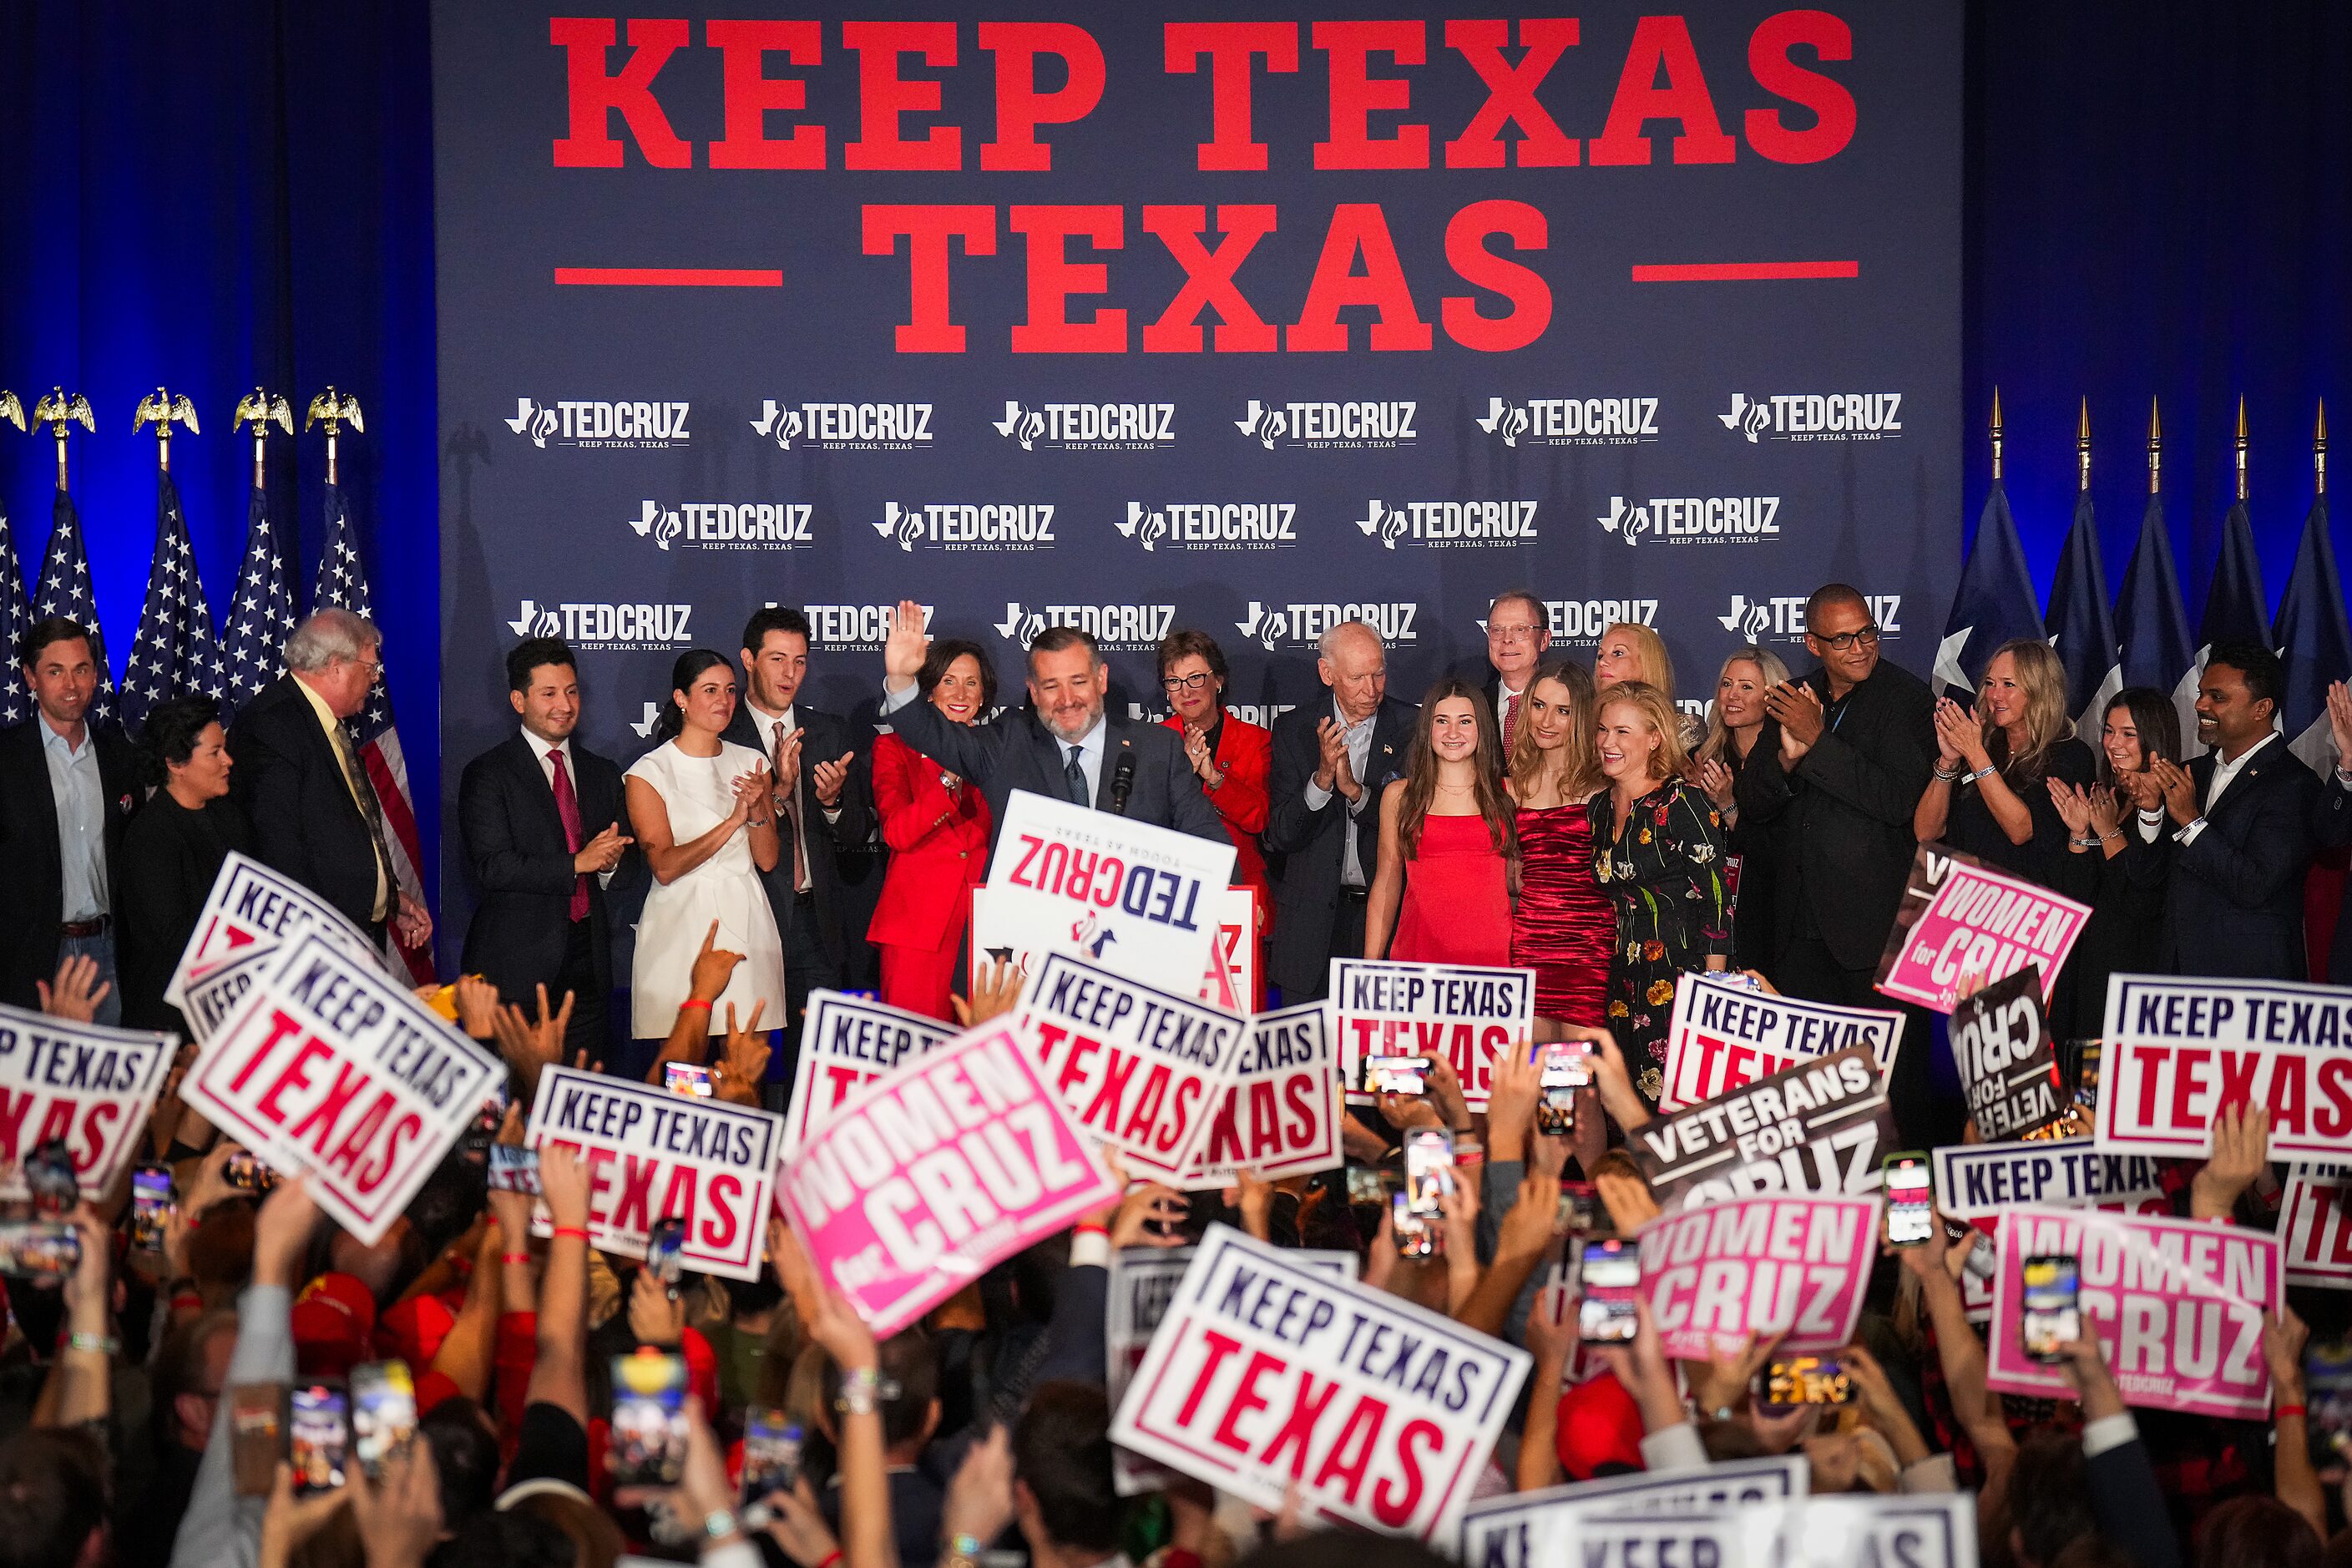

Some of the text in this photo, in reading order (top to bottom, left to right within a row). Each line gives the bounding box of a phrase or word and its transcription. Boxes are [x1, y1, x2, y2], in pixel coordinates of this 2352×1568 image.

[550, 9, 1858, 171] KEEP TEXAS
[862, 200, 1554, 353] TEXAS
[558, 402, 689, 438] TEDCRUZ
[802, 403, 933, 440] TEDCRUZ
[1044, 404, 1175, 441] TEDCRUZ
[1287, 402, 1417, 438] TEDCRUZ
[1528, 398, 1658, 436] TEDCRUZ
[1770, 393, 1901, 431] TEDCRUZ
[579, 440, 602, 448] KEEP
[605, 441, 637, 449] TEXAS,
[848, 443, 880, 451] TEXAS,
[1091, 443, 1123, 451] TEXAS,
[1333, 441, 1364, 449] TEXAS,
[1368, 440, 1396, 448] TEXAS
[1609, 437, 1638, 445] TEXAS
[1817, 433, 1849, 442] TEXAS,
[1851, 432, 1881, 441] TEXAS
[681, 504, 812, 541] TEDCRUZ
[924, 505, 1055, 541] TEDCRUZ
[1166, 504, 1297, 541] TEDCRUZ
[1408, 501, 1538, 538] TEDCRUZ
[1649, 497, 1780, 534] TEDCRUZ
[728, 543, 760, 551] TEXAS,
[1212, 543, 1244, 551] TEXAS,
[1428, 539, 1517, 549] KEEP TEXAS, TEXAS
[1696, 536, 1727, 544] TEXAS,
[560, 604, 691, 641] TEDCRUZ
[803, 605, 934, 642] TEDCRZ
[1541, 599, 1658, 637] EDCRUZ
[1770, 595, 1901, 634] TEUZ
[581, 642, 604, 650] KEEP
[607, 643, 639, 651] TEXAS,
[1098, 644, 1123, 652] EXAS,
[1936, 875, 2075, 956] WOMEN
[1910, 940, 1937, 966] for
[1353, 974, 1514, 1018] KEEP TEXAS
[292, 959, 467, 1110] KEEP TEXAS
[1050, 970, 1227, 1067] KEEP TEXAS
[1701, 993, 1879, 1057] KEEP TEXAS
[2137, 993, 2235, 1039] KEEP
[833, 1015, 911, 1069] KEEP
[1239, 1023, 1313, 1075] XAS
[1955, 994, 2041, 1089] CRU
[25, 1034, 142, 1091] TEXAS
[229, 1009, 422, 1193] TEXAS
[1643, 1056, 1871, 1164] VETERANS
[1971, 1072, 2007, 1110] FOR
[2132, 1045, 2352, 1139] TEXAS
[559, 1088, 753, 1166] KEEP TEXAS
[1207, 1074, 1317, 1164] XAS
[1977, 1081, 2058, 1141] VETER
[0, 1086, 119, 1176] XAS
[788, 1035, 1034, 1231] WOMEN
[1737, 1117, 1807, 1164] FOR
[863, 1100, 1086, 1275] CRUZ
[1965, 1156, 2053, 1207] KEEP
[1652, 1258, 1849, 1336] CRUZ
[1218, 1265, 1335, 1346] KEEP
[1336, 1313, 1480, 1413] TEXAS
[1174, 1328, 1445, 1529] TEXAS
